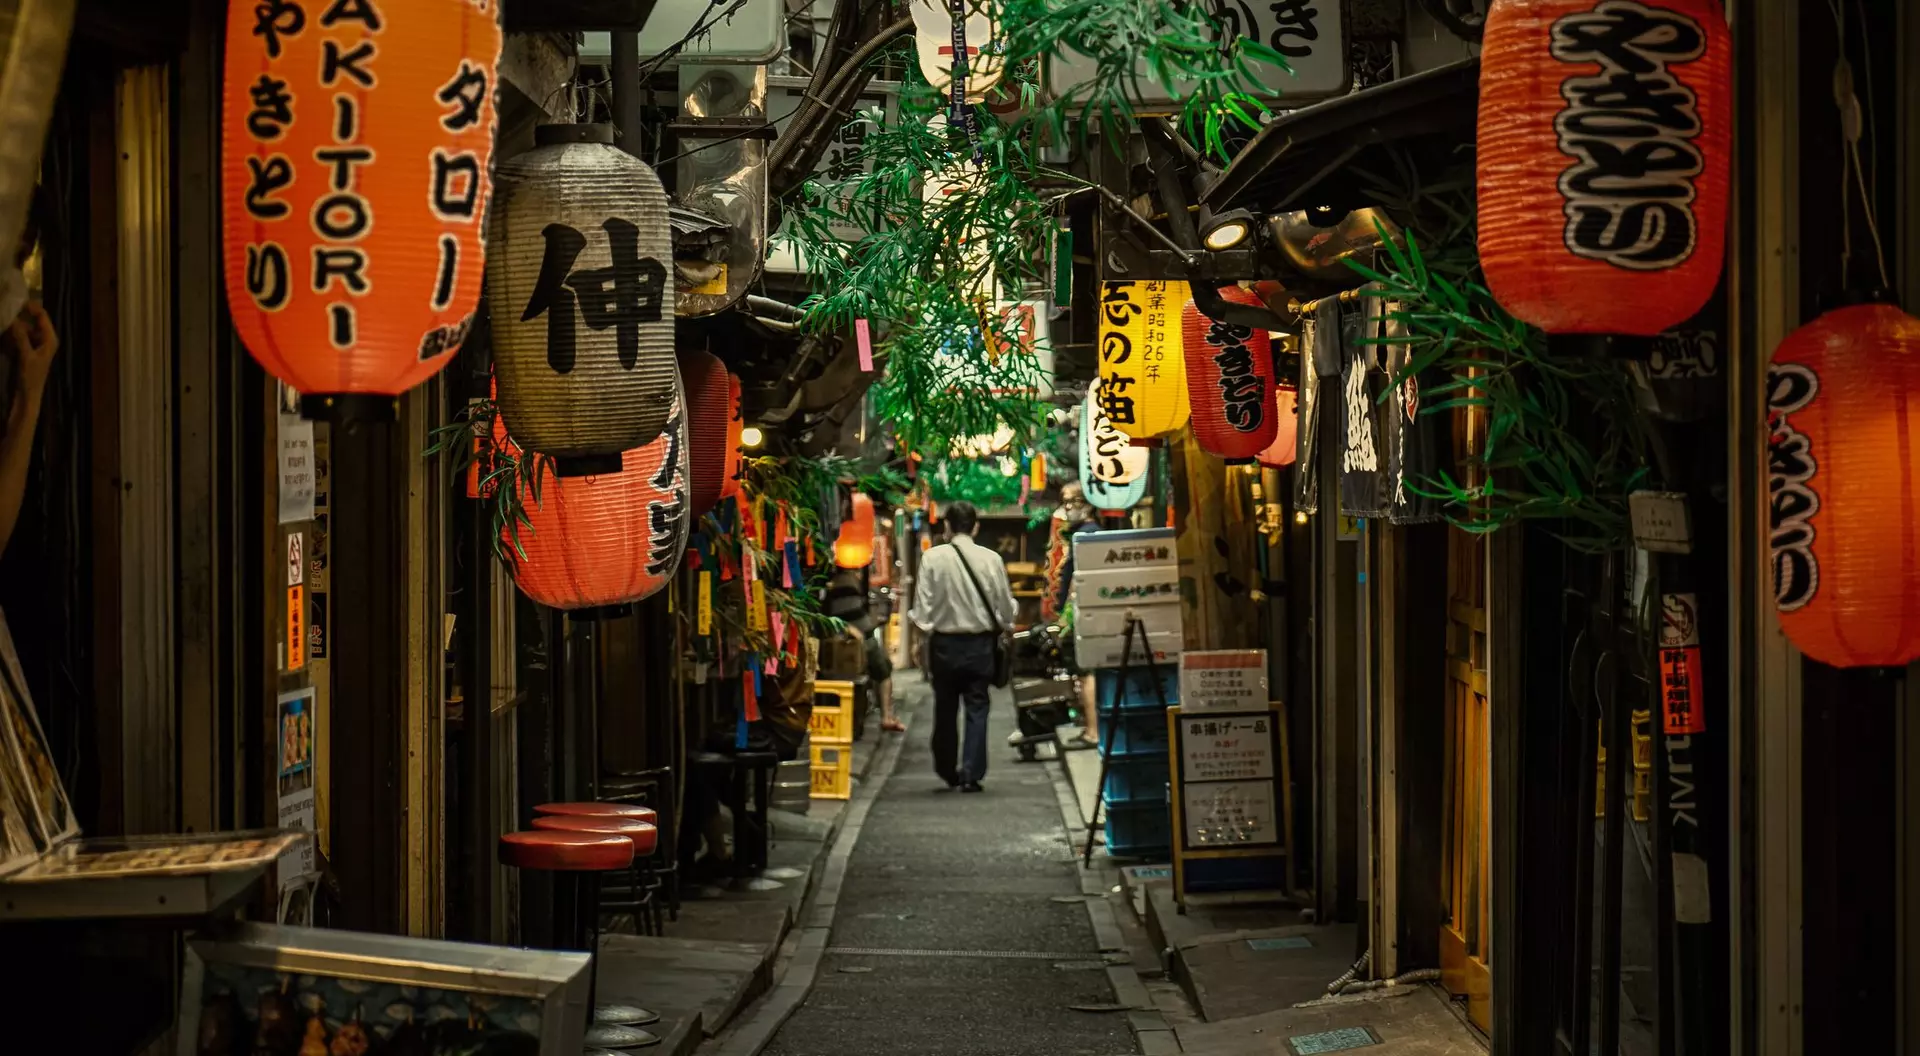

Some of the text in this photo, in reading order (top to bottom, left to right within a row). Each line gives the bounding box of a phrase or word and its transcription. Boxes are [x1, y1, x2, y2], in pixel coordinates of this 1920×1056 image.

[245, 0, 306, 312] やきとり
[428, 58, 488, 311] タロー
[1549, 0, 1707, 270] やきとり
[520, 217, 669, 375] 伸
